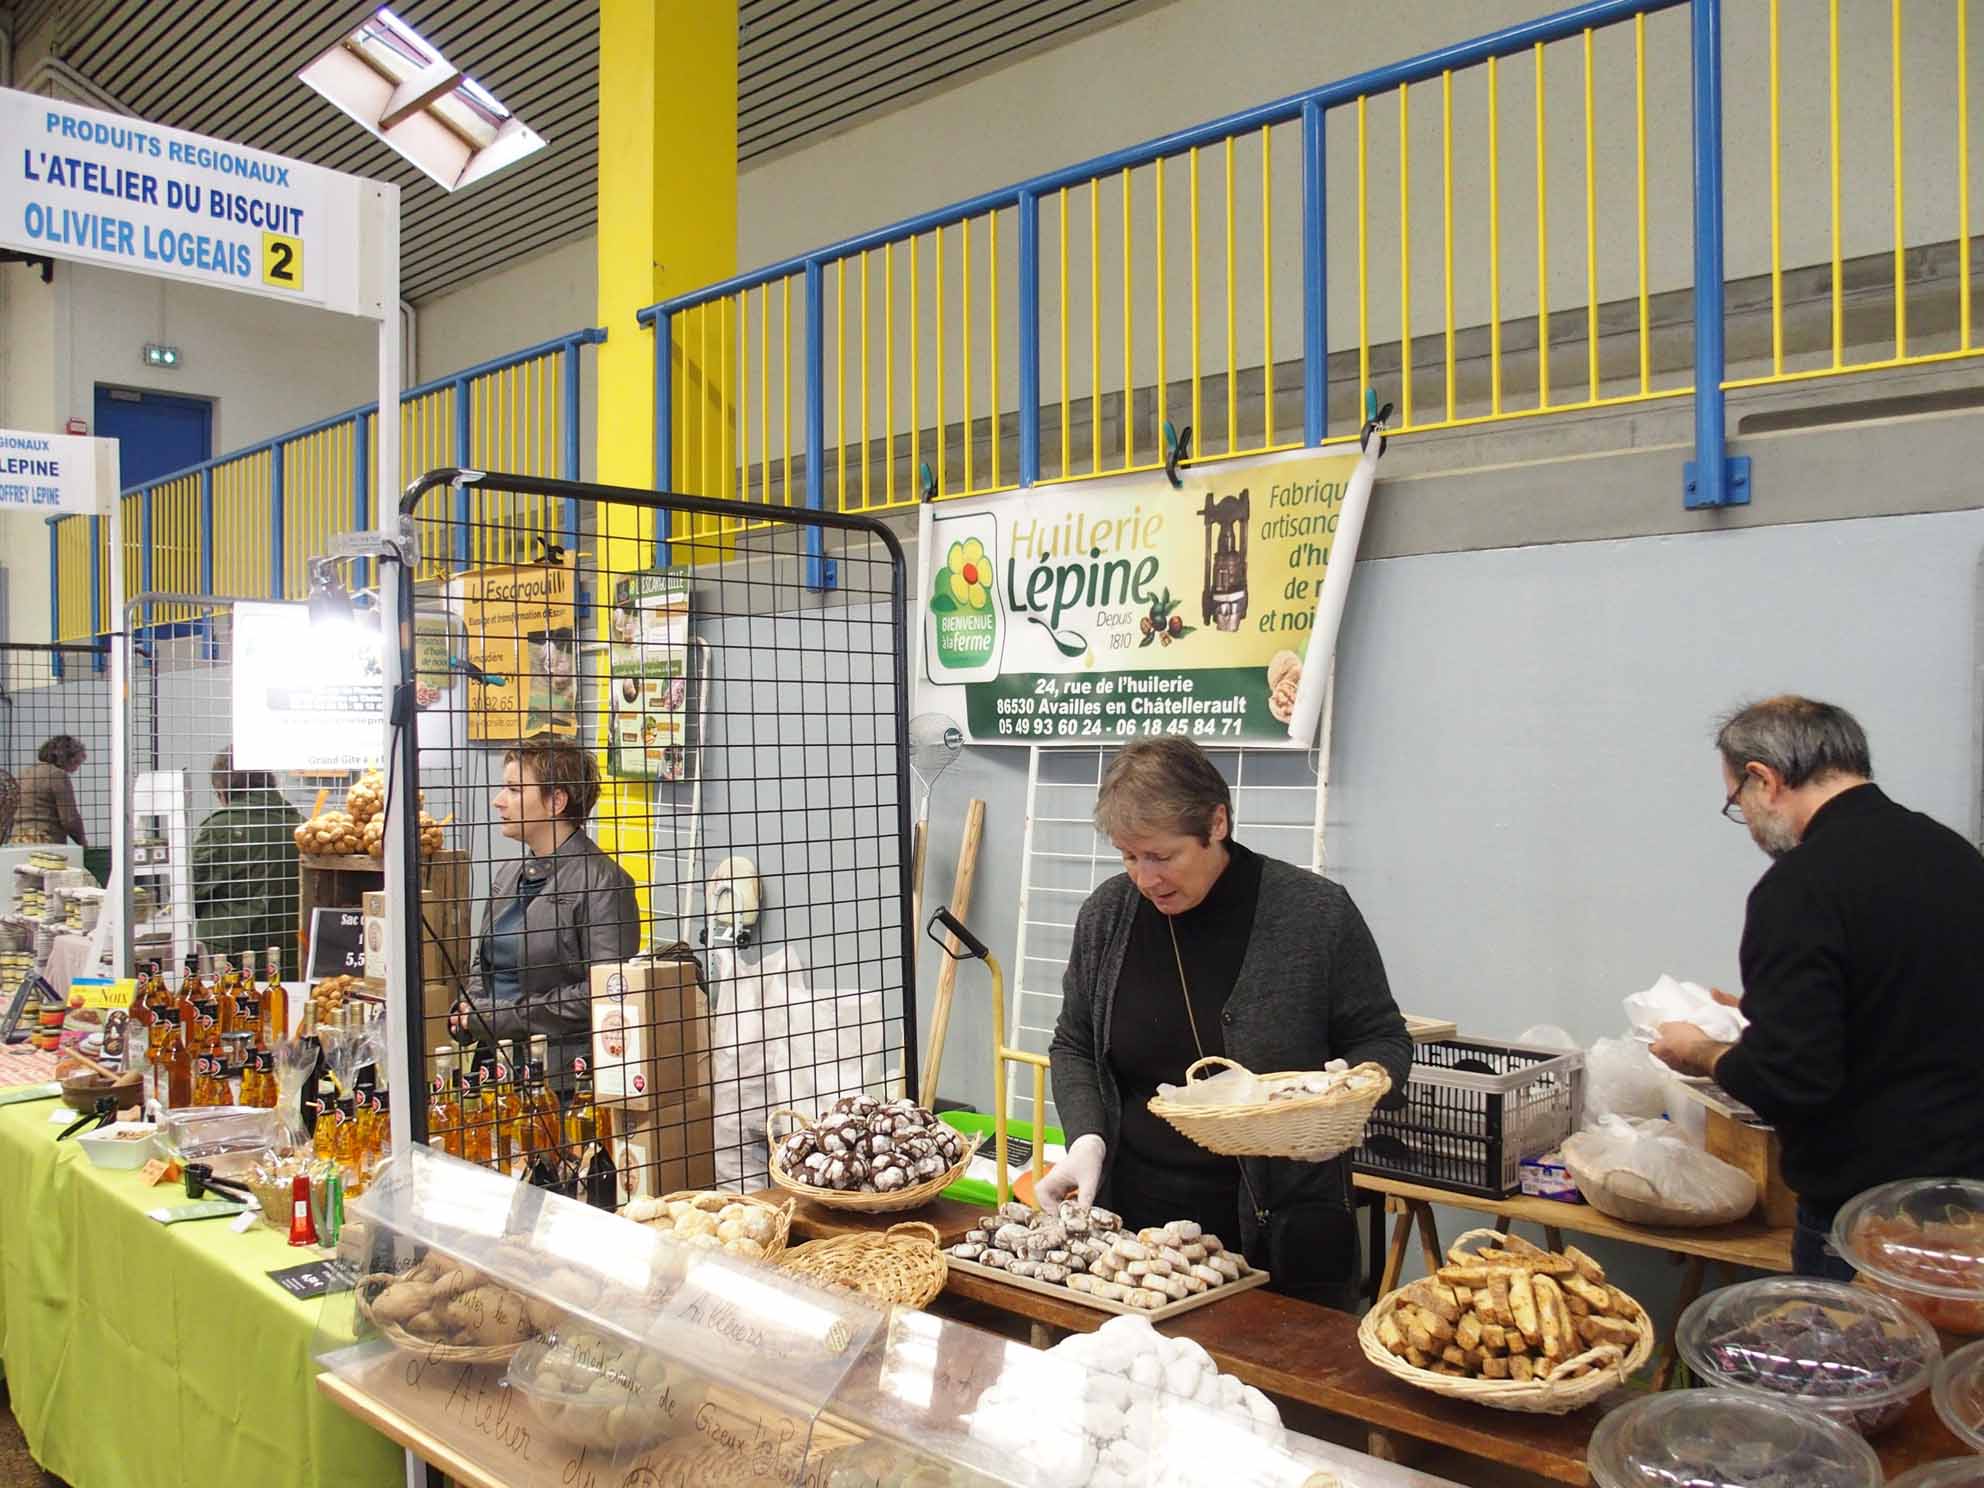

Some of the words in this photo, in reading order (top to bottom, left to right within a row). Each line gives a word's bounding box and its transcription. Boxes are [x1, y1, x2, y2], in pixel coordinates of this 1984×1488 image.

[46, 112, 162, 157] PRODUITS
[168, 141, 290, 188] REGIONAUX
[25, 149, 158, 205] L'ATELIER
[167, 181, 201, 214] DU
[210, 190, 304, 236] BISCUIT
[25, 202, 135, 256] OLIVIER
[144, 225, 252, 278] LOGEAIS
[269, 242, 293, 281] 2
[0, 458, 59, 477] LEPINE
[32, 486, 60, 505] LEPINE
[1010, 504, 1165, 560] Huilerie
[1008, 547, 1160, 630] Lépine
[1284, 576, 1309, 600] de
[942, 614, 993, 632] BIENVENUE
[1097, 611, 1132, 628] Depuis
[1259, 609, 1277, 633] et
[953, 632, 992, 652] ferme
[1109, 633, 1132, 650] 1810
[1034, 678, 1059, 698] 24,
[1063, 681, 1092, 695] rue
[1096, 677, 1113, 694] de
[1118, 676, 1193, 694] l'huilerie
[997, 699, 1034, 715] 86530
[1038, 698, 1101, 715] Availles
[1105, 701, 1126, 715] en
[1131, 696, 1247, 714] Châtellerault
[999, 719, 1012, 735] 05
[1015, 719, 1030, 735] 49
[1033, 719, 1053, 735] 93
[1057, 719, 1078, 735] 60
[1081, 719, 1102, 735] 24
[1116, 719, 1136, 735] 06
[1142, 719, 1162, 735] 18
[1166, 718, 1189, 735] 45
[1193, 718, 1216, 735] 84
[1221, 718, 1243, 735] 71
[341, 914, 359, 926] Sac
